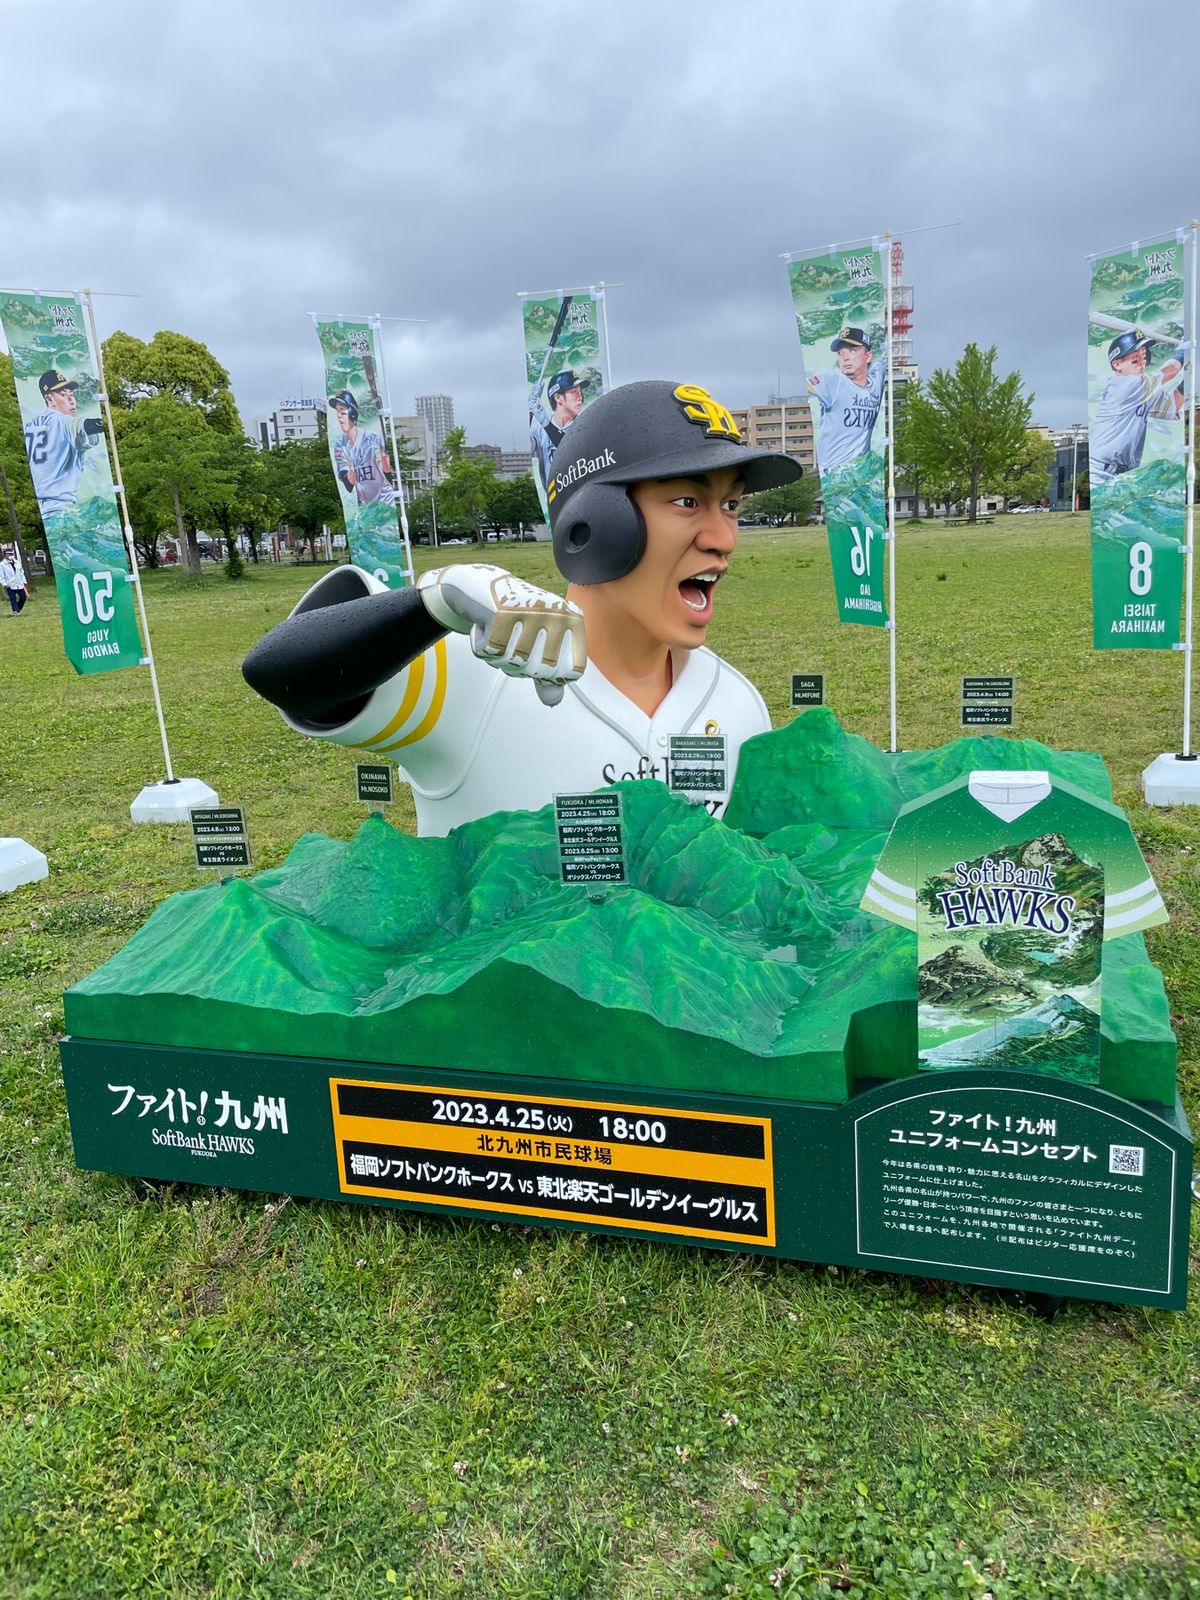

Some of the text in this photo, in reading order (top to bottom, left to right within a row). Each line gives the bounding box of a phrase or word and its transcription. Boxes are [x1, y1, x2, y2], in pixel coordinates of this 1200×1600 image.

[556, 448, 617, 493] SoftBank
[955, 859, 1057, 890] SoftBank
[936, 885, 1076, 936] HAWKS
[107, 1082, 289, 1135] ファイト!九州
[431, 1099, 667, 1144] 2023.4.25(火) 18:00
[929, 1109, 1057, 1137] ファイト！九州
[151, 1128, 256, 1155] SoftBank HAWKS
[190, 1150, 218, 1158] FUKUOKA
[476, 1134, 613, 1165] 北九州市民球場
[888, 1128, 1099, 1164] ユニフォームコンセプト
[349, 1153, 515, 1193] 福岡ソフトバンクホークス
[536, 1175, 759, 1224] 東北楽天ゴールデンイーグルス
[882, 1171, 984, 1189] ユニフォームに仕上げました。
